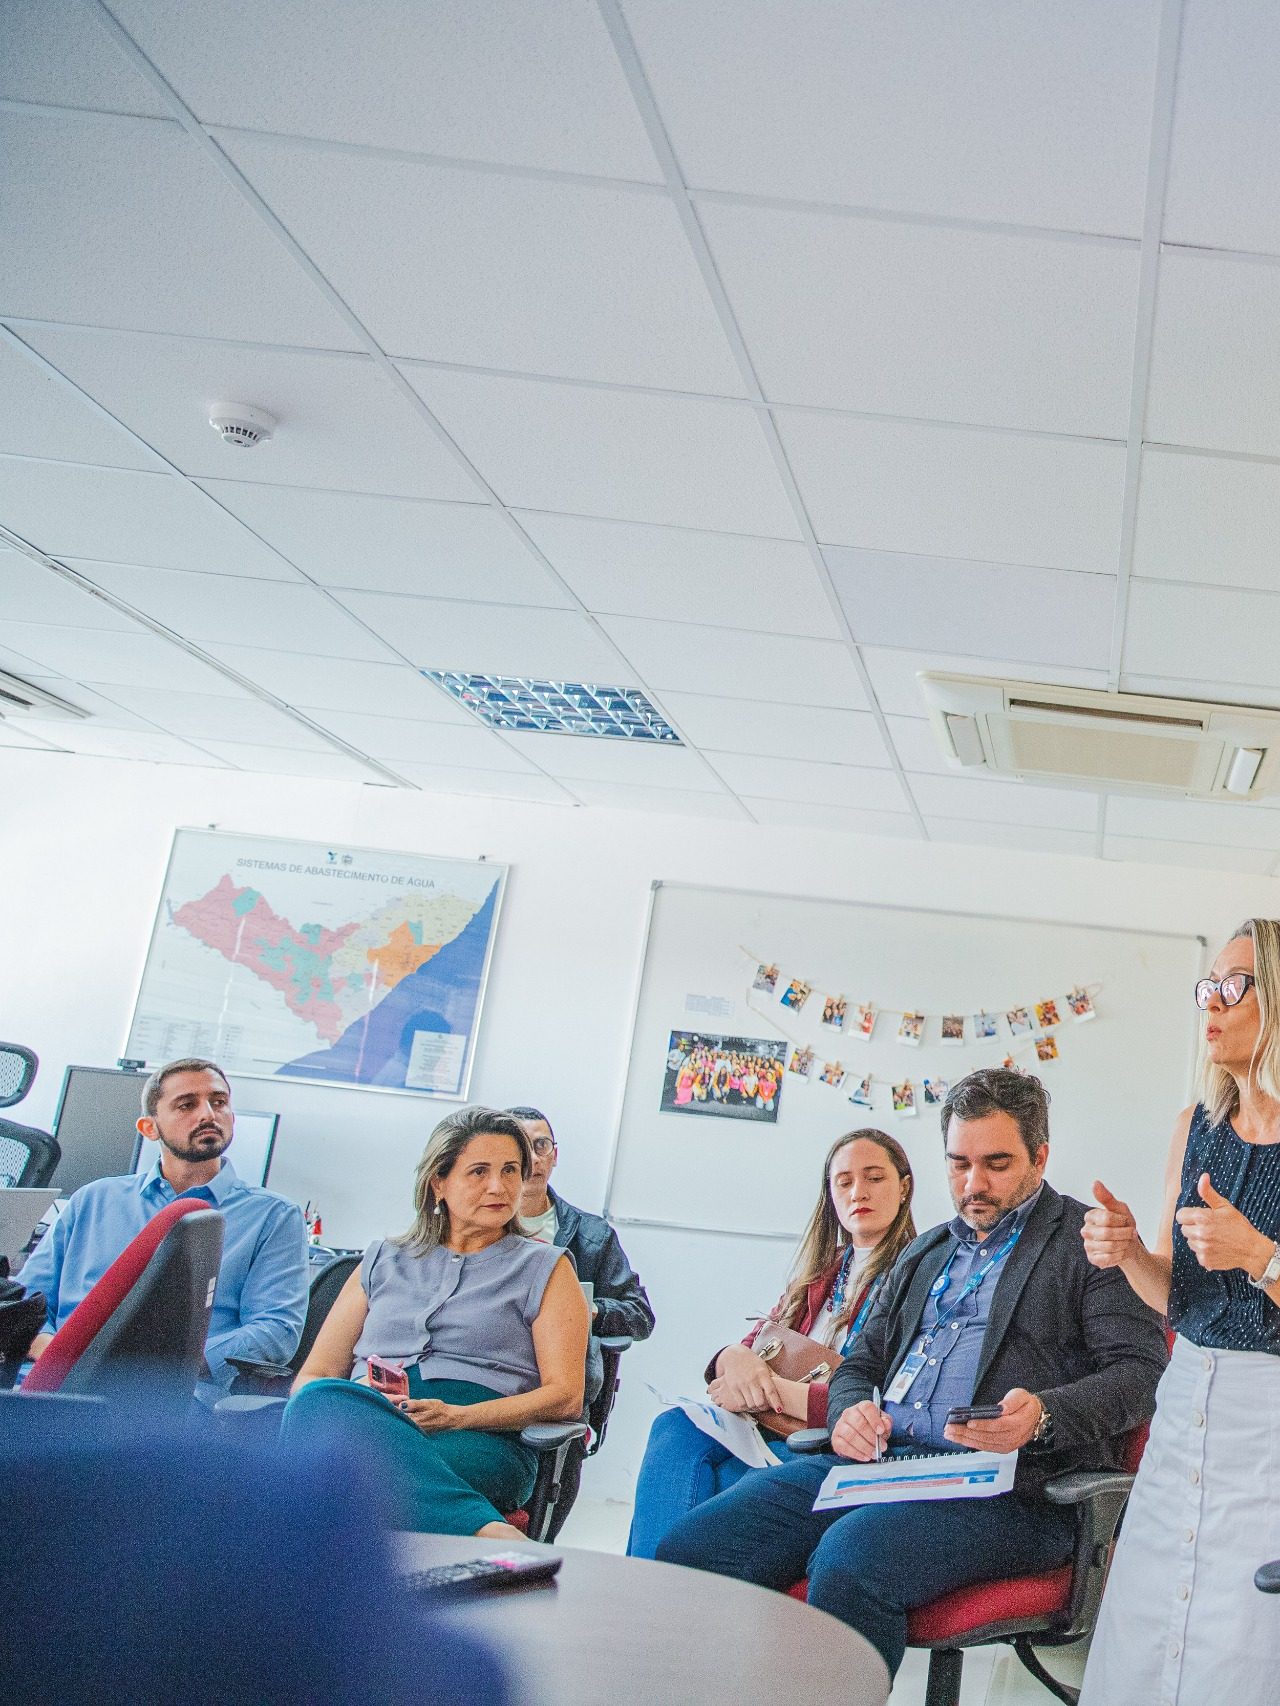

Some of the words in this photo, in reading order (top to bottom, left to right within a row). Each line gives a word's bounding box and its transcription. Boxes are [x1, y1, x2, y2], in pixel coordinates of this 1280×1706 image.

[237, 858, 287, 872] SISTEMAS
[289, 864, 303, 874] DE
[304, 866, 389, 884] ABASTECIMENTO
[391, 875, 405, 886] DE
[407, 875, 435, 889] ÁGUA
